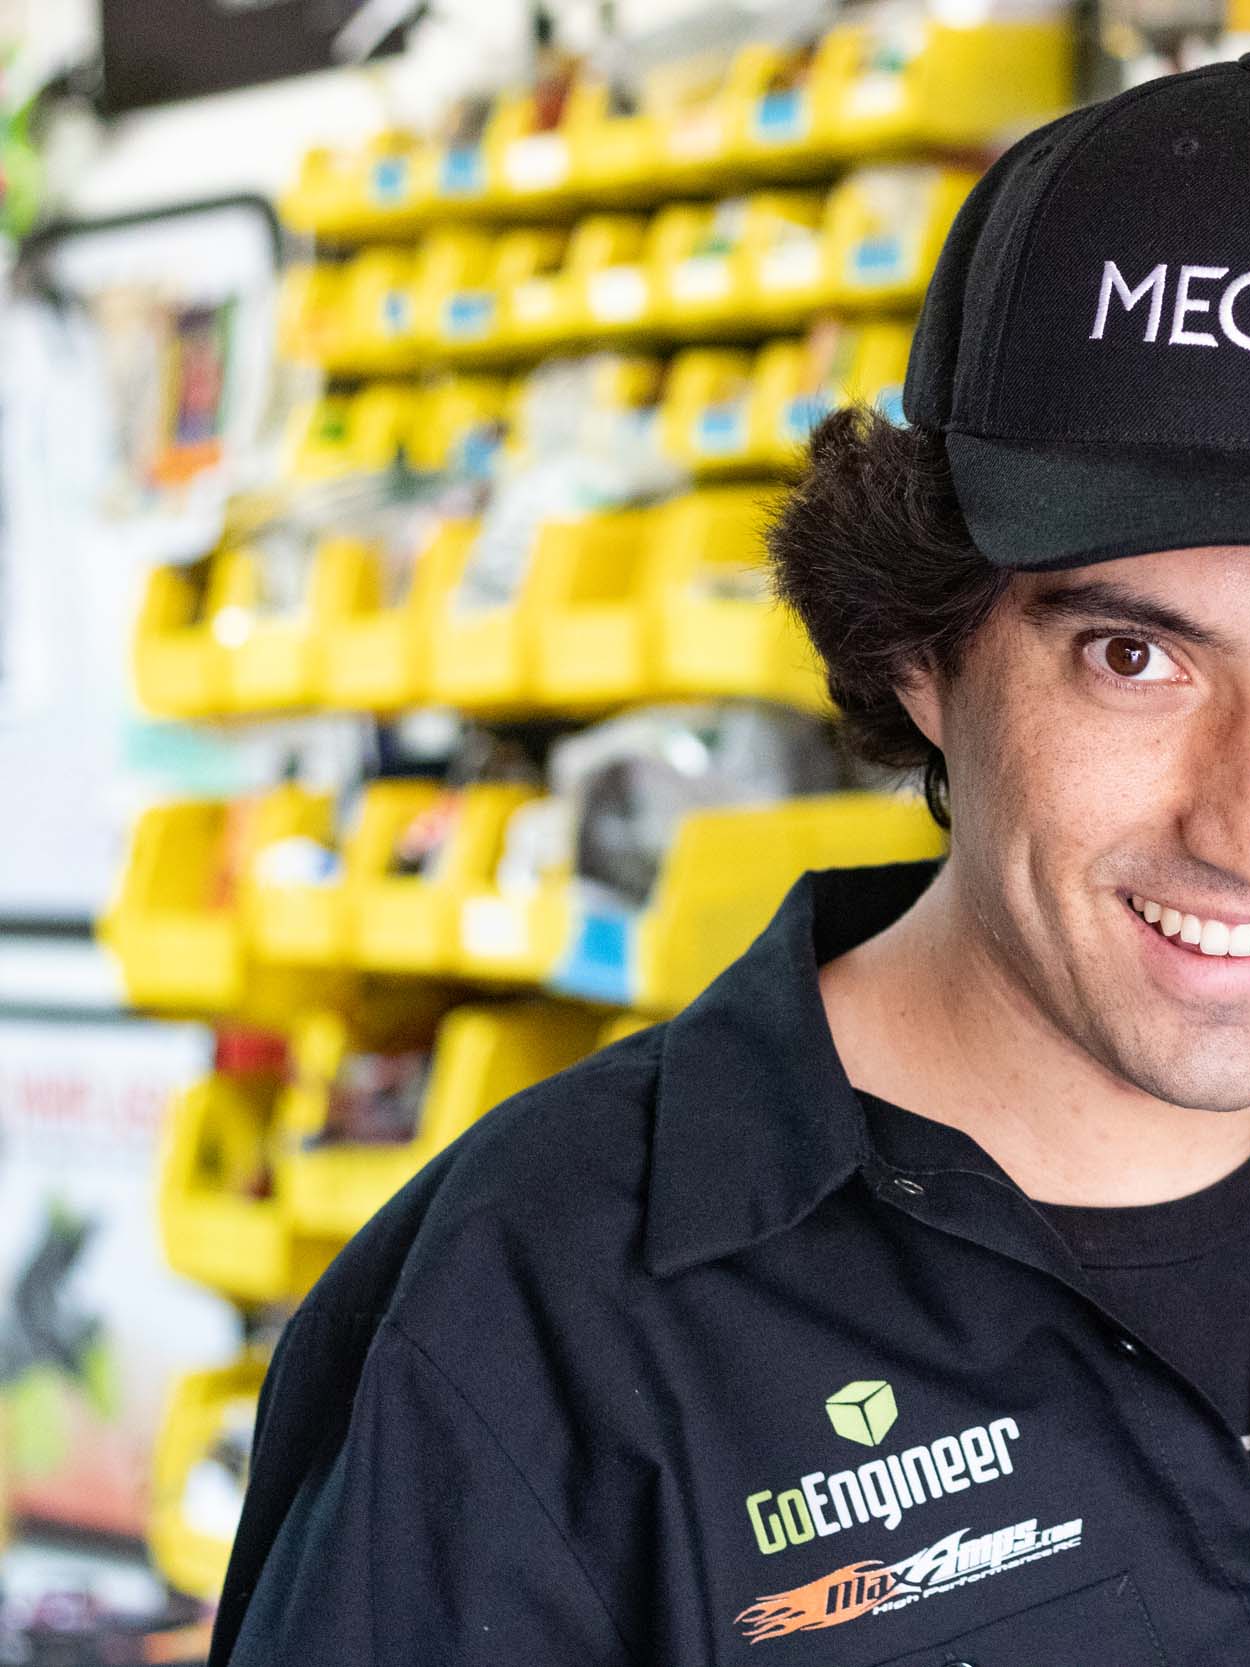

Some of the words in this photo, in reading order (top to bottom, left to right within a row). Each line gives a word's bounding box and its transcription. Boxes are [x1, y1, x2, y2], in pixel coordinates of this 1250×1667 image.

[746, 1416, 1020, 1554] GoEngineer
[872, 1594, 920, 1616] High
[922, 1548, 1054, 1599] Performance
[1053, 1536, 1083, 1556] RC
